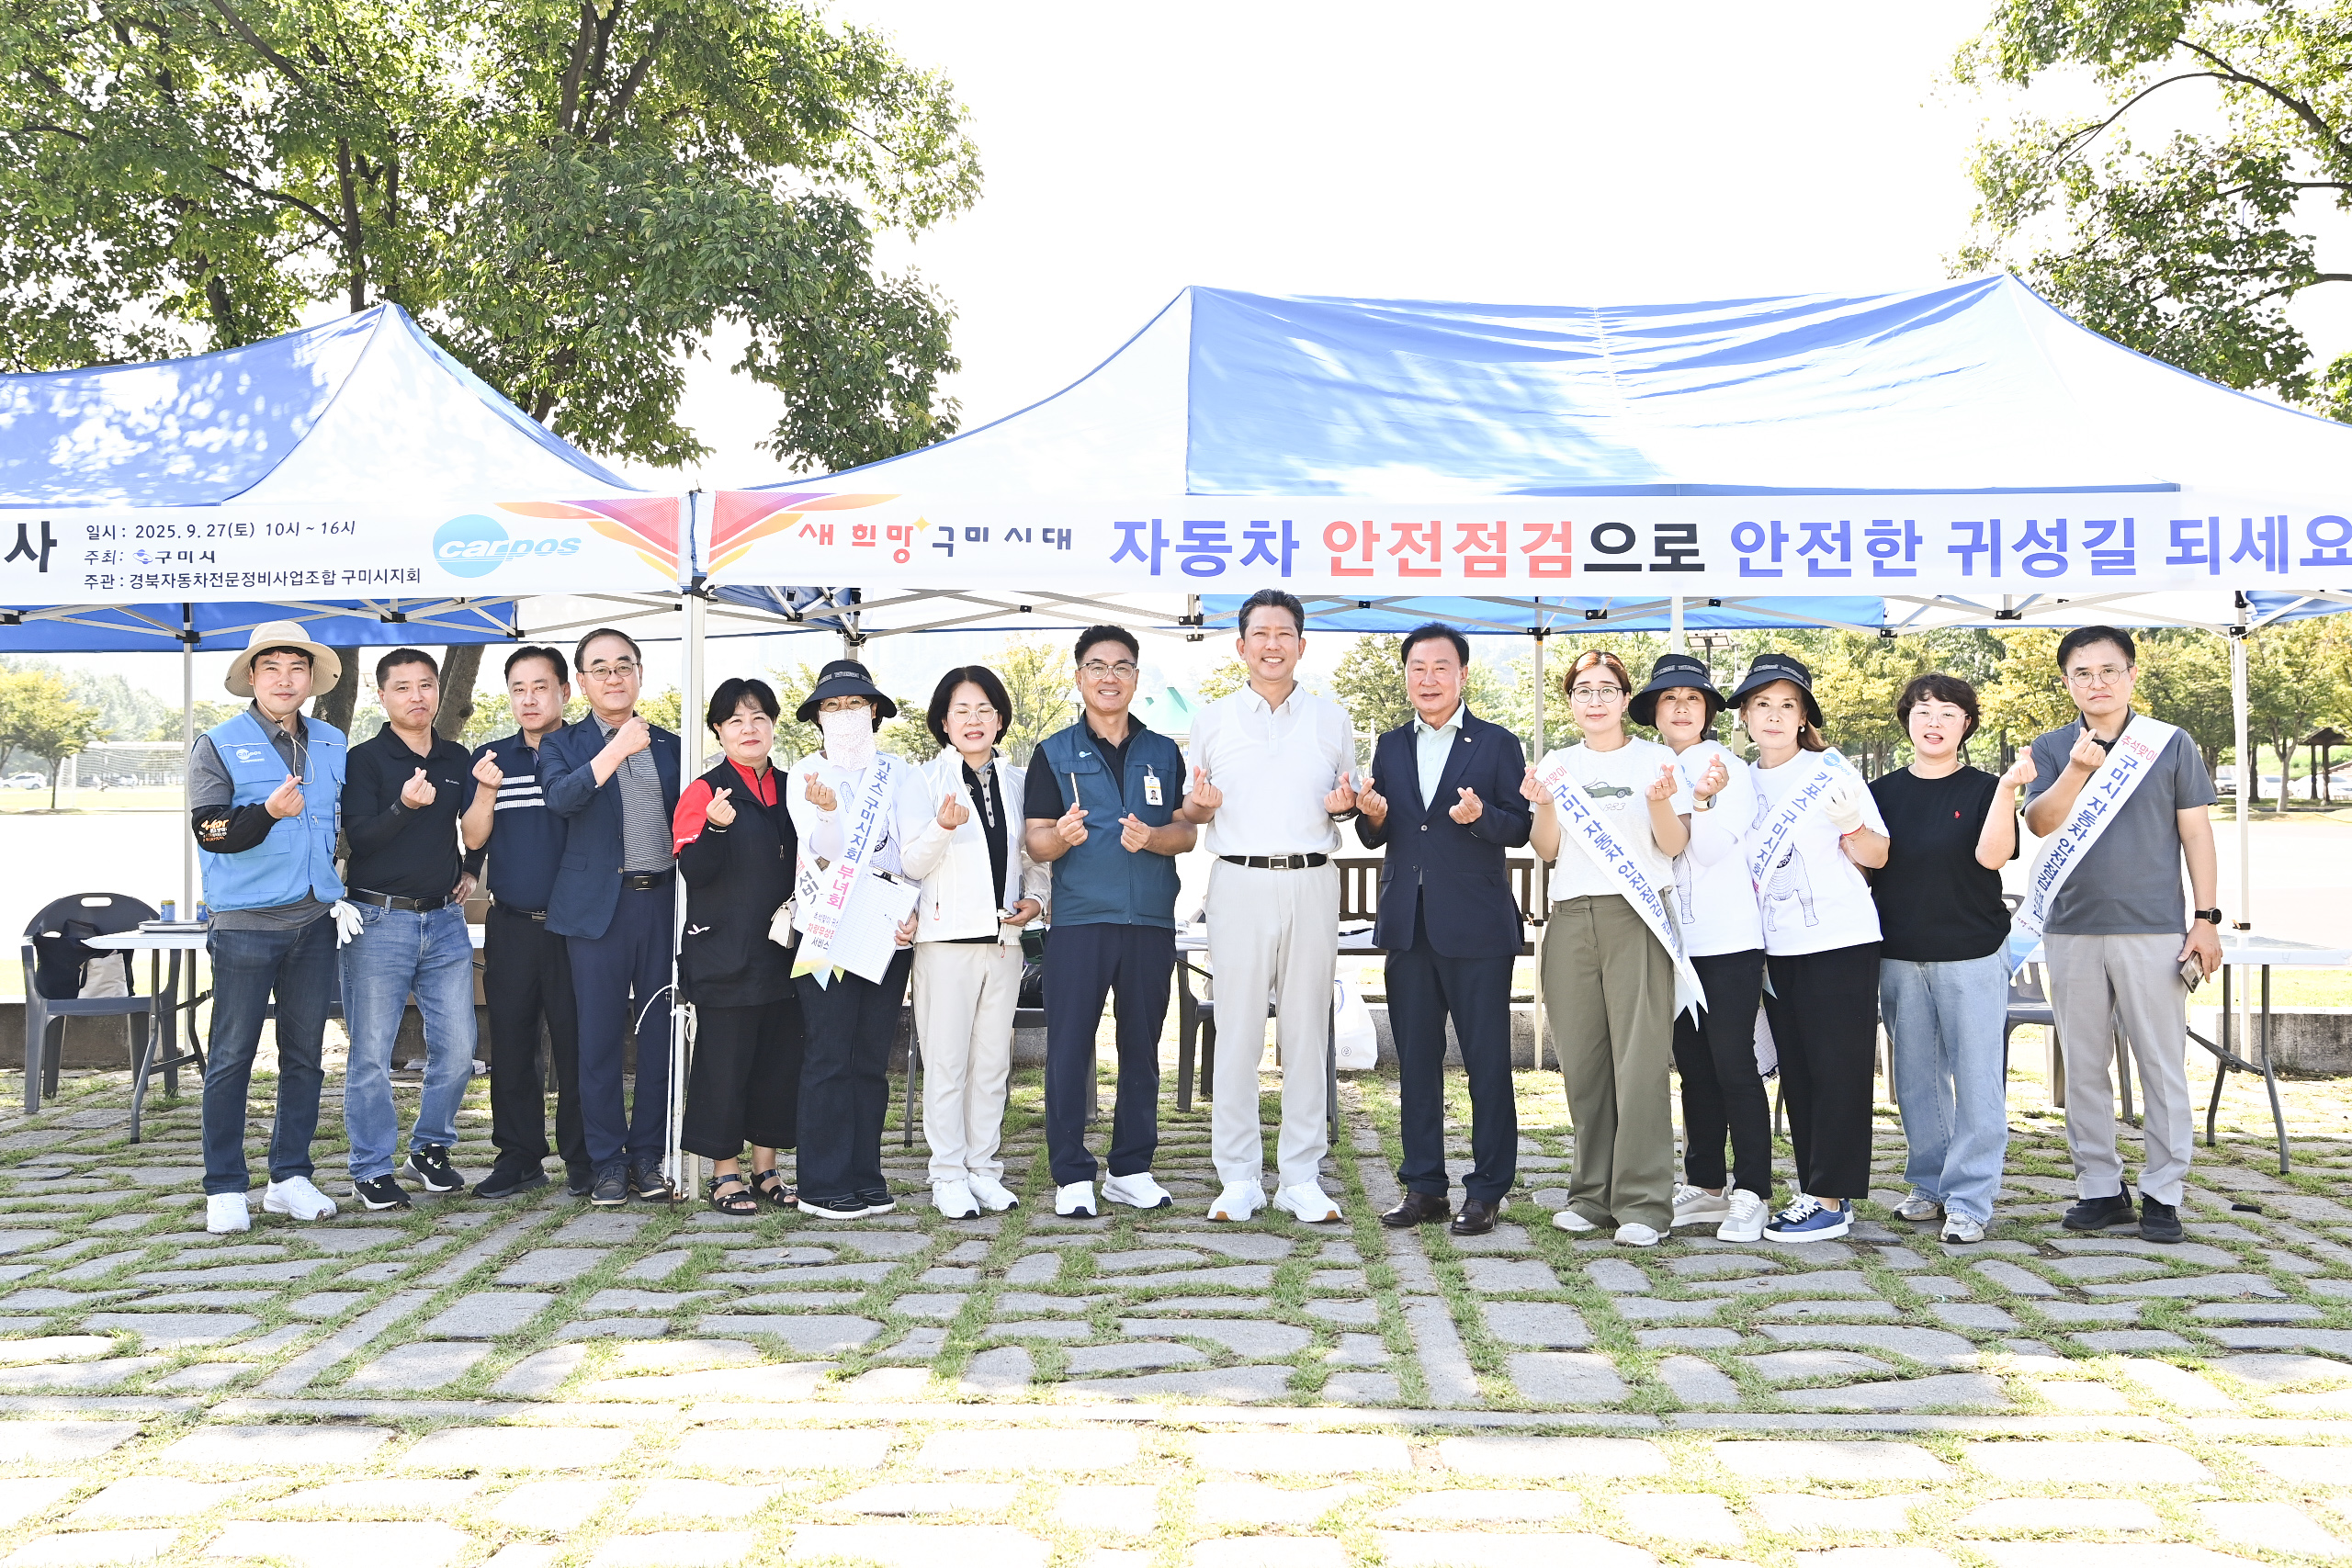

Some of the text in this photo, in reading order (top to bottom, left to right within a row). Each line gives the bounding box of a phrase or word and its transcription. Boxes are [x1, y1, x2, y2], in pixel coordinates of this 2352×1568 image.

[4, 520, 58, 573] 사
[206, 522, 254, 538] 27(토)
[266, 521, 300, 536] 10시
[321, 520, 356, 536] 16시
[437, 536, 582, 561] carpos
[1108, 514, 2352, 579] 자동차 안전점검으로 안전한 귀성길 되세요
[130, 570, 337, 590] 경북자동차전문정비사업조합
[341, 568, 421, 586] 구미시지회
[2120, 735, 2157, 763] 추석맞이
[1544, 765, 1567, 787] 석맞이
[2099, 754, 2138, 800] 구미시
[2067, 796, 2109, 841] 자동차
[1553, 784, 1591, 824] 구미시
[1583, 819, 1625, 863] 자동차
[1617, 860, 1664, 918] 안전점검
[2037, 837, 2076, 892] 안전점검
[827, 864, 854, 910] 부녀회
